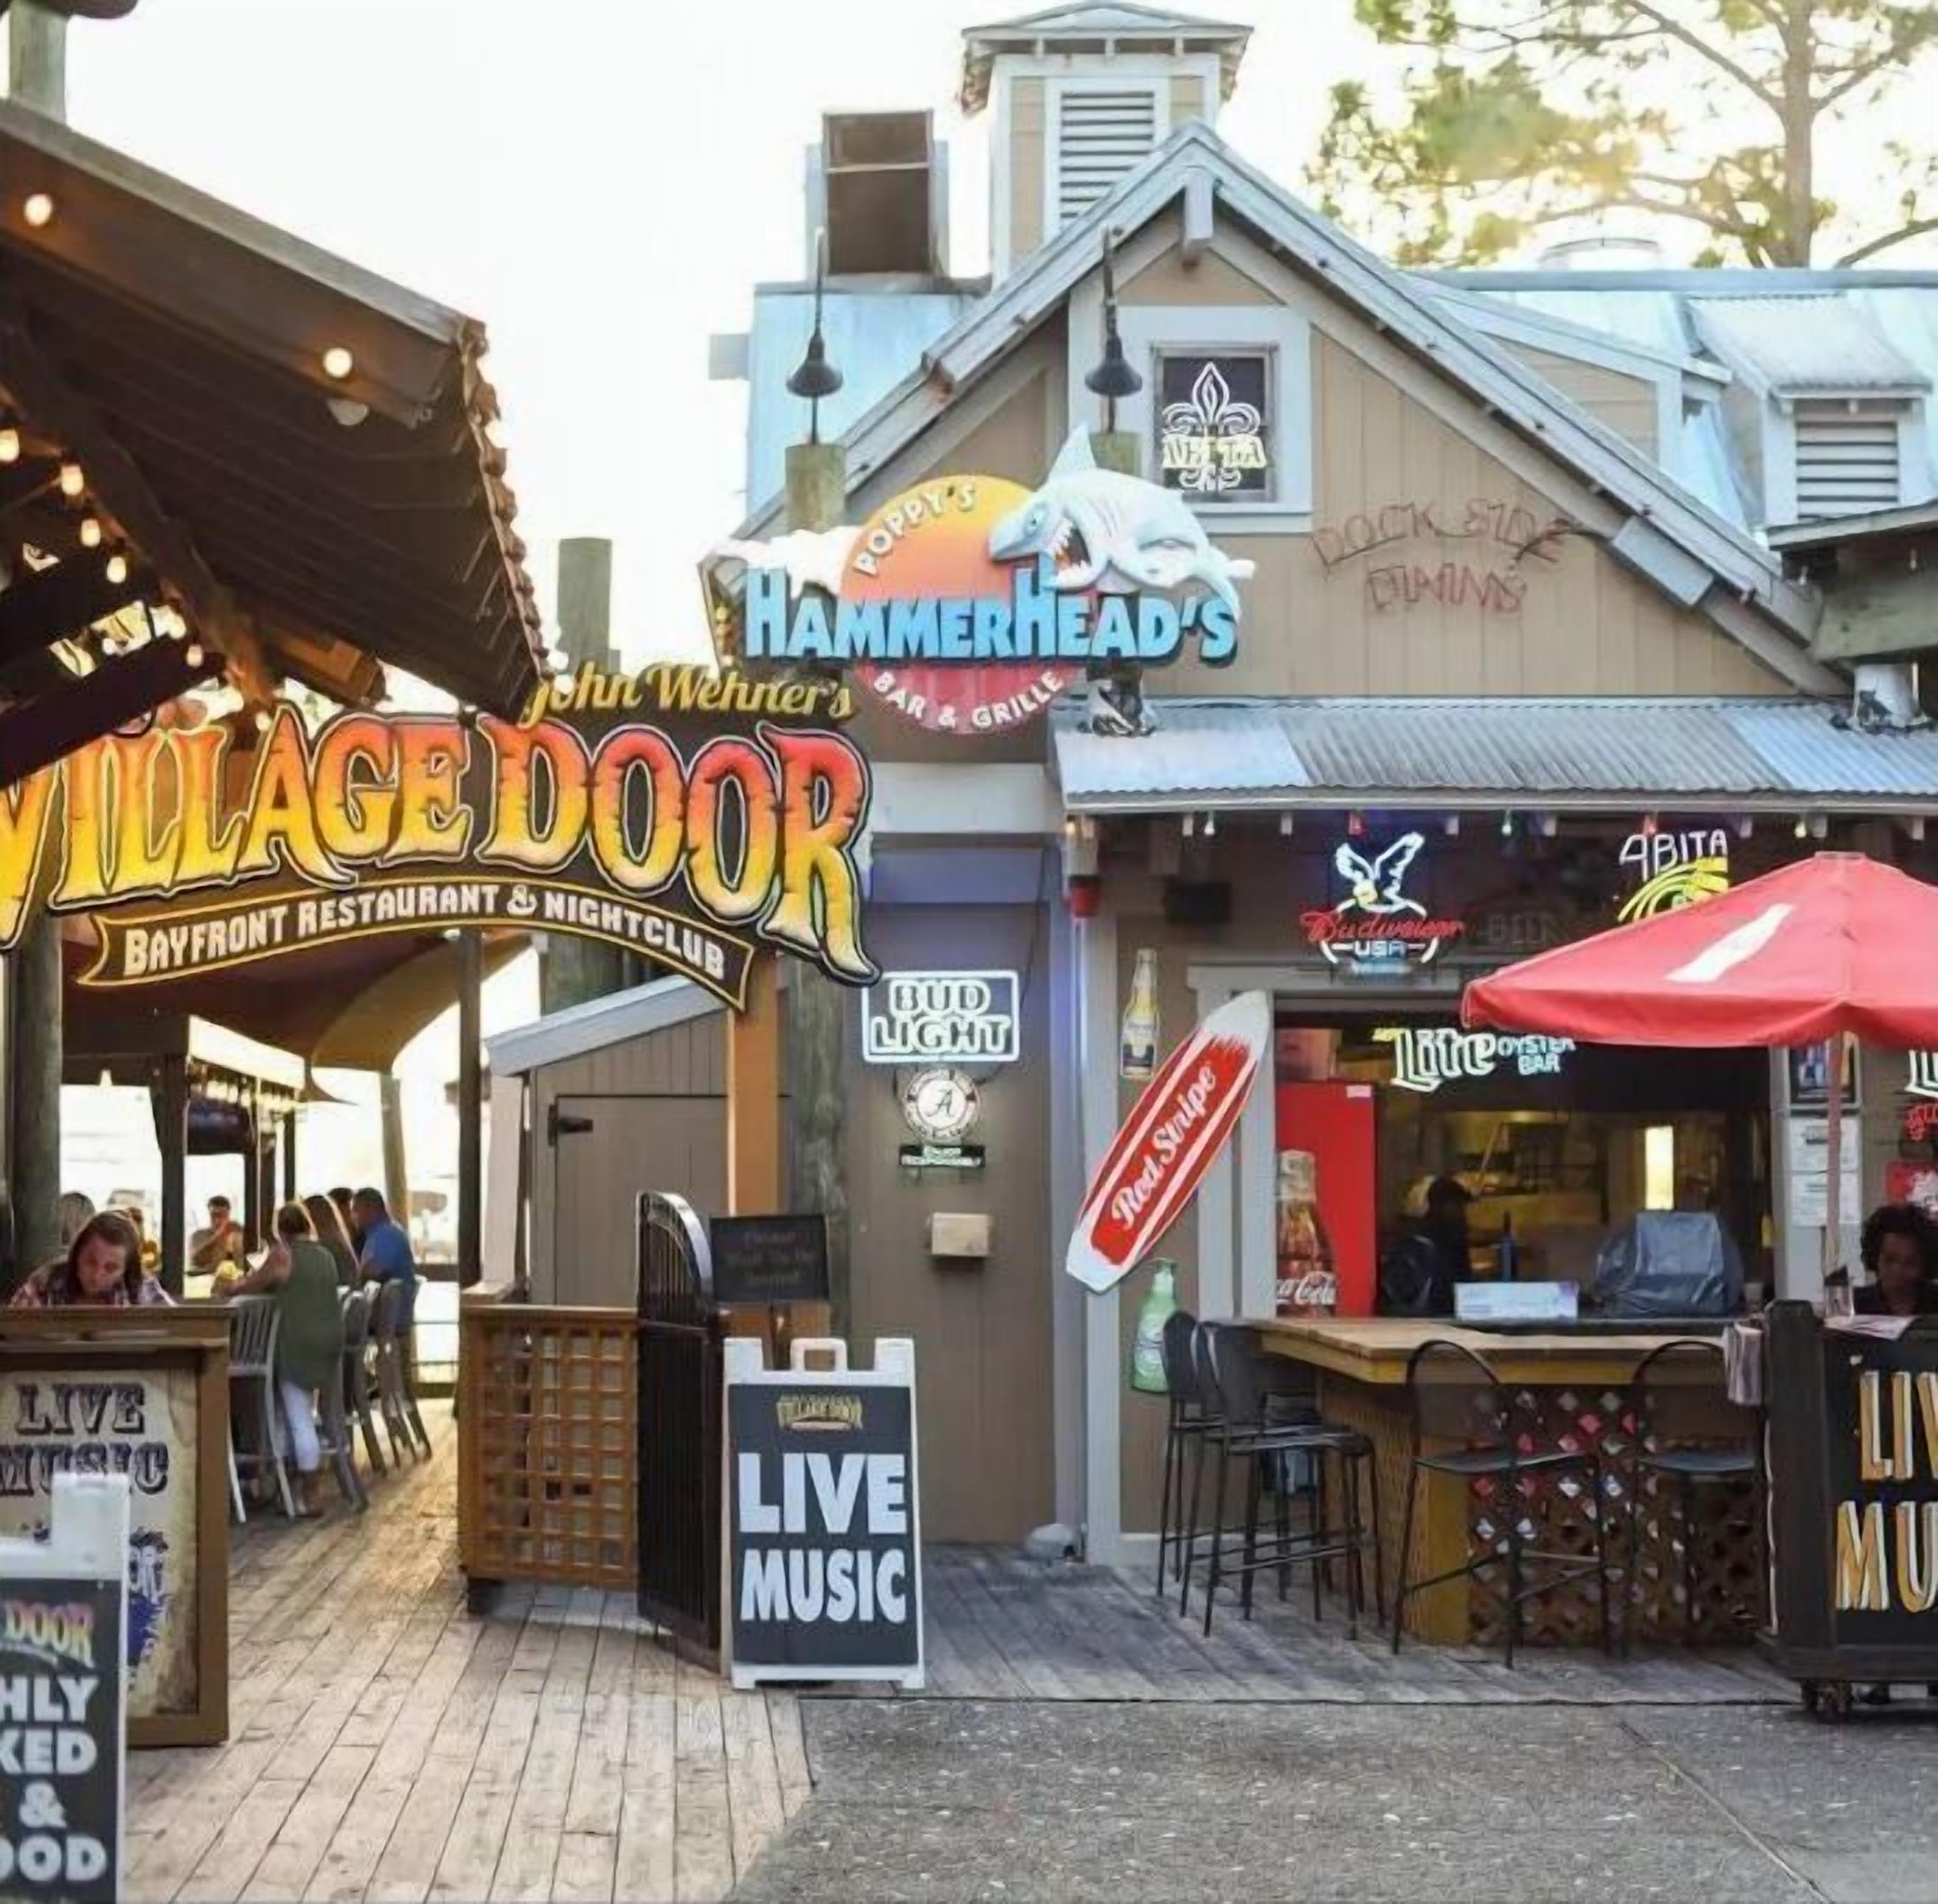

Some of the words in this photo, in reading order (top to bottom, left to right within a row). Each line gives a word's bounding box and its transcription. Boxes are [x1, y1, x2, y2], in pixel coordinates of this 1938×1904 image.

[853, 483, 977, 576] POPPY'S
[1311, 501, 1435, 570] DOCK
[745, 556, 1239, 660] HAMMERHEAD'S
[517, 661, 642, 729] John
[646, 662, 853, 720] Wehner's
[872, 668, 925, 720] BAR
[937, 704, 958, 728] &
[971, 671, 1064, 728] GRILLE
[477, 713, 878, 981] DOOR
[1619, 829, 1728, 881] ABITA
[124, 901, 288, 976] BAYFRONT
[298, 884, 499, 938] RESTAURANT
[507, 885, 537, 916] &
[543, 890, 726, 979] NIGHTCLUB
[1354, 940, 1407, 957] USA
[889, 980, 991, 1016] BUD
[870, 1015, 1010, 1054] LIGHT
[1518, 1053, 1561, 1075] BAR
[1112, 1154, 1166, 1229] Red
[1153, 1060, 1216, 1165] Stripe
[15, 1382, 145, 1434] LIVE
[739, 1452, 907, 1534] LIVE
[740, 1549, 906, 1623] MUSIC
[4, 1600, 95, 1668] DOOR
[19, 1780, 67, 1828] &
